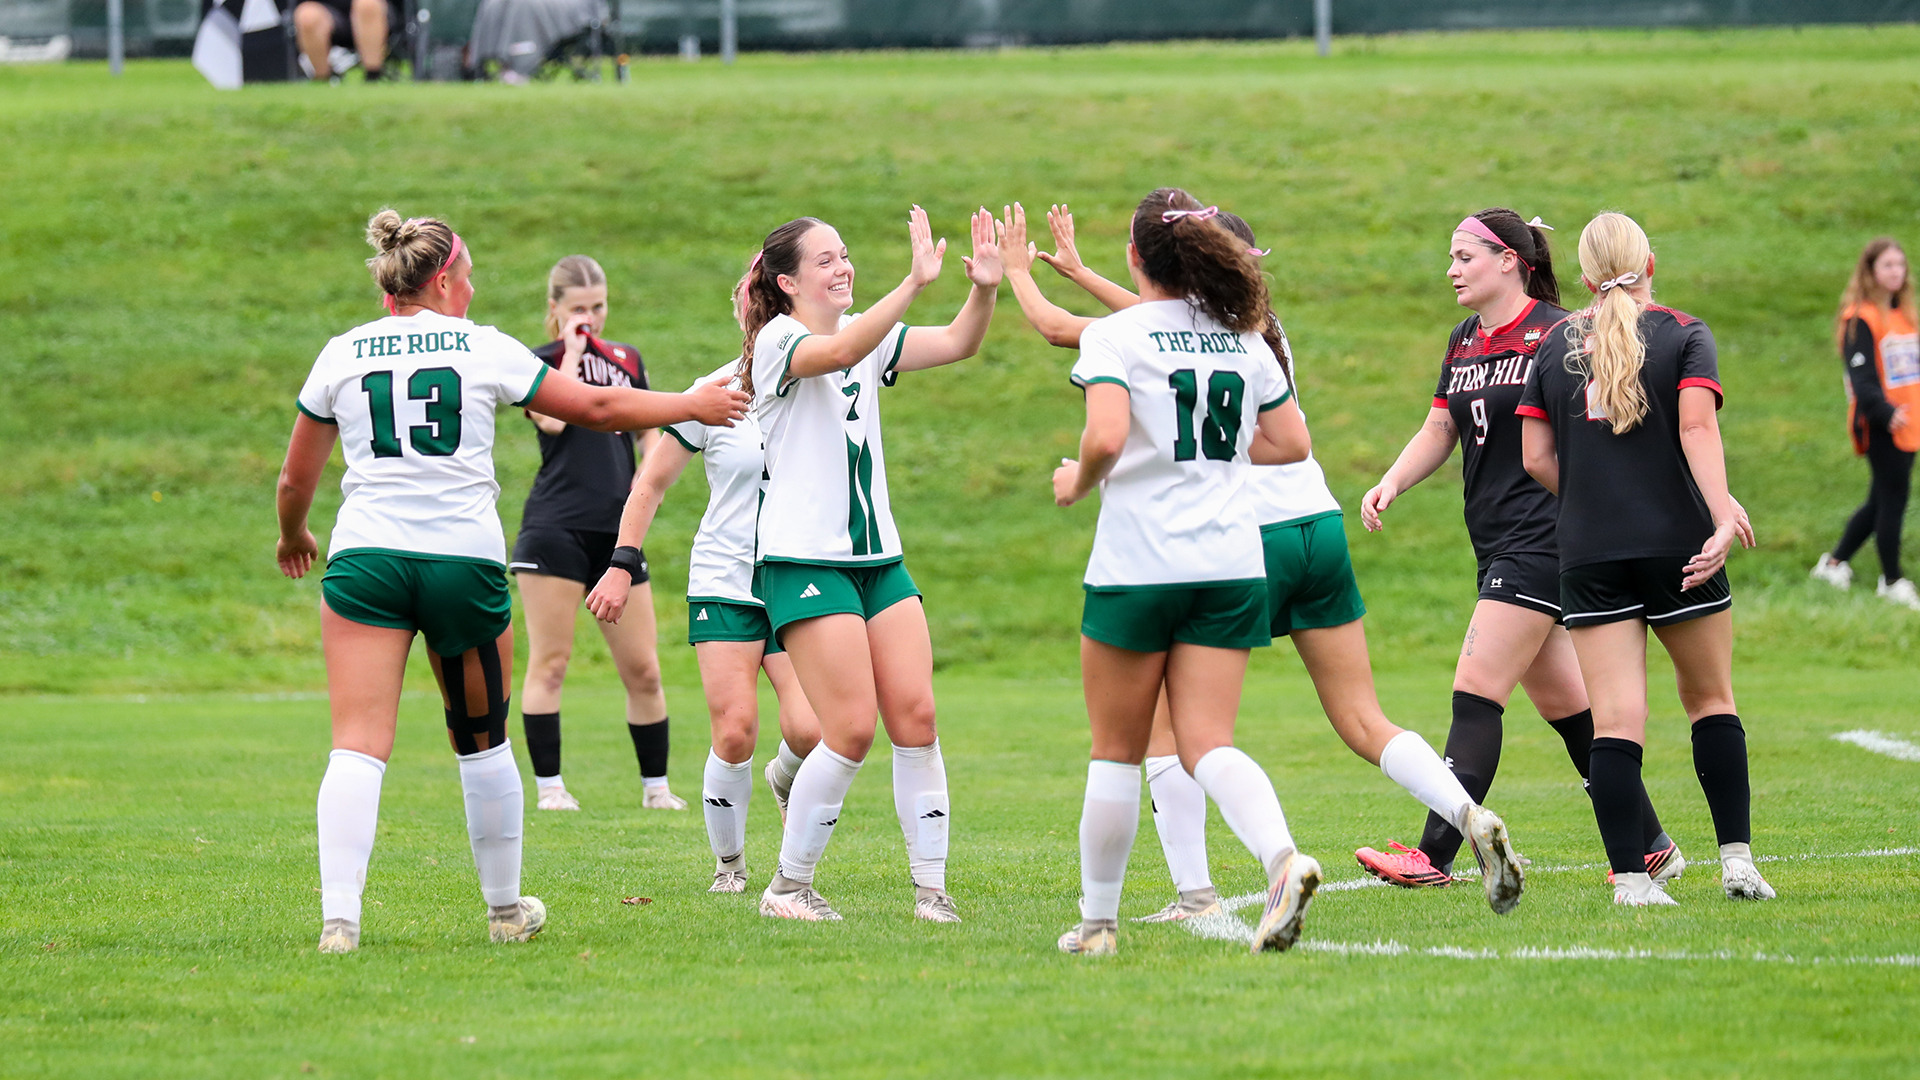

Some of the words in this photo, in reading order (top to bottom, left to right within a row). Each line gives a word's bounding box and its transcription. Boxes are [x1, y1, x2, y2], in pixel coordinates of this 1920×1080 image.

[353, 335, 402, 359] THE
[407, 331, 471, 353] ROCK
[1149, 331, 1196, 353] THE
[1200, 332, 1248, 354] ROCK
[361, 366, 463, 459] 13
[841, 381, 861, 421] 7
[1168, 369, 1245, 462] 18
[1470, 398, 1489, 446] 9
